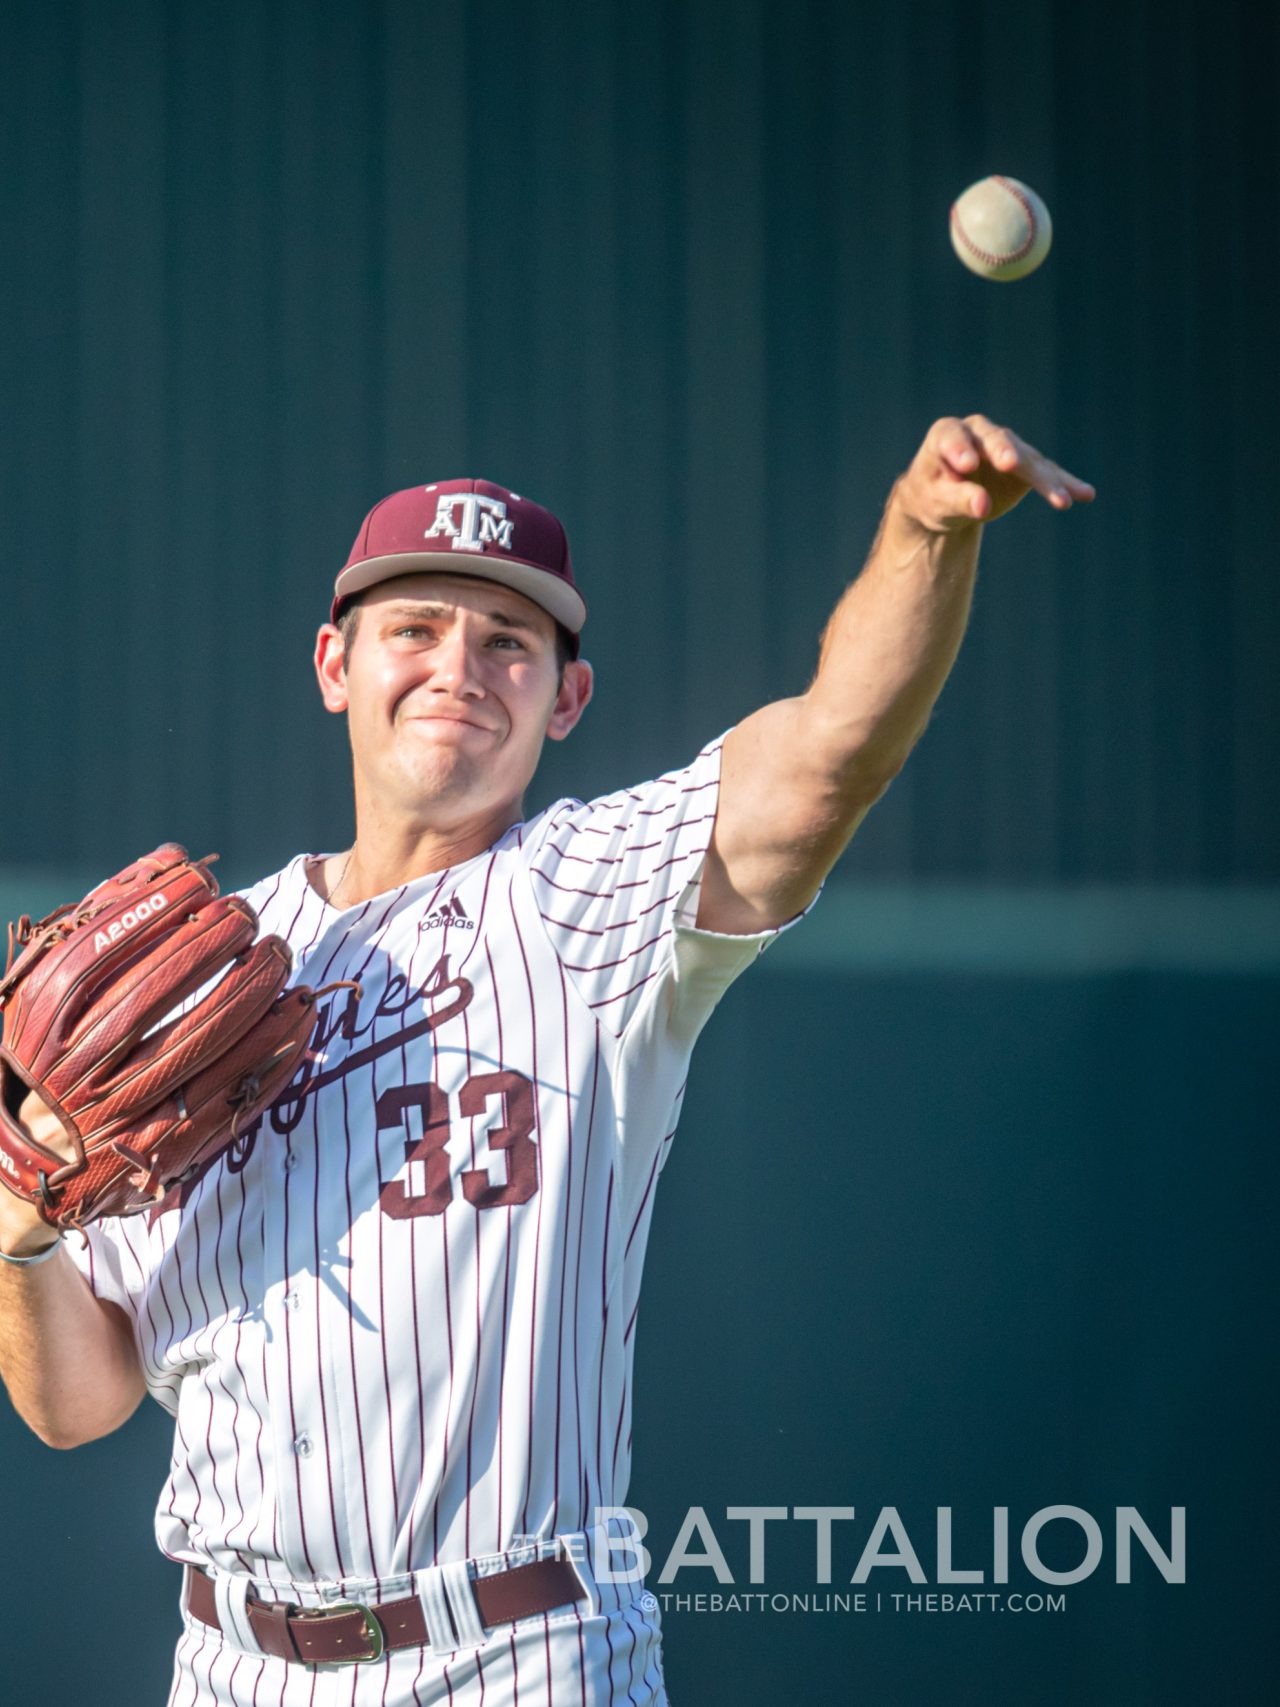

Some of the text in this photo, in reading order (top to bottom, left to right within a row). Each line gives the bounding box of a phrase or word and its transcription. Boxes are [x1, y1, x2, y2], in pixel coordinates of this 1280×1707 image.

[94, 893, 168, 954] A2000
[421, 915, 475, 932] adidas
[375, 1069, 539, 1221] 33
